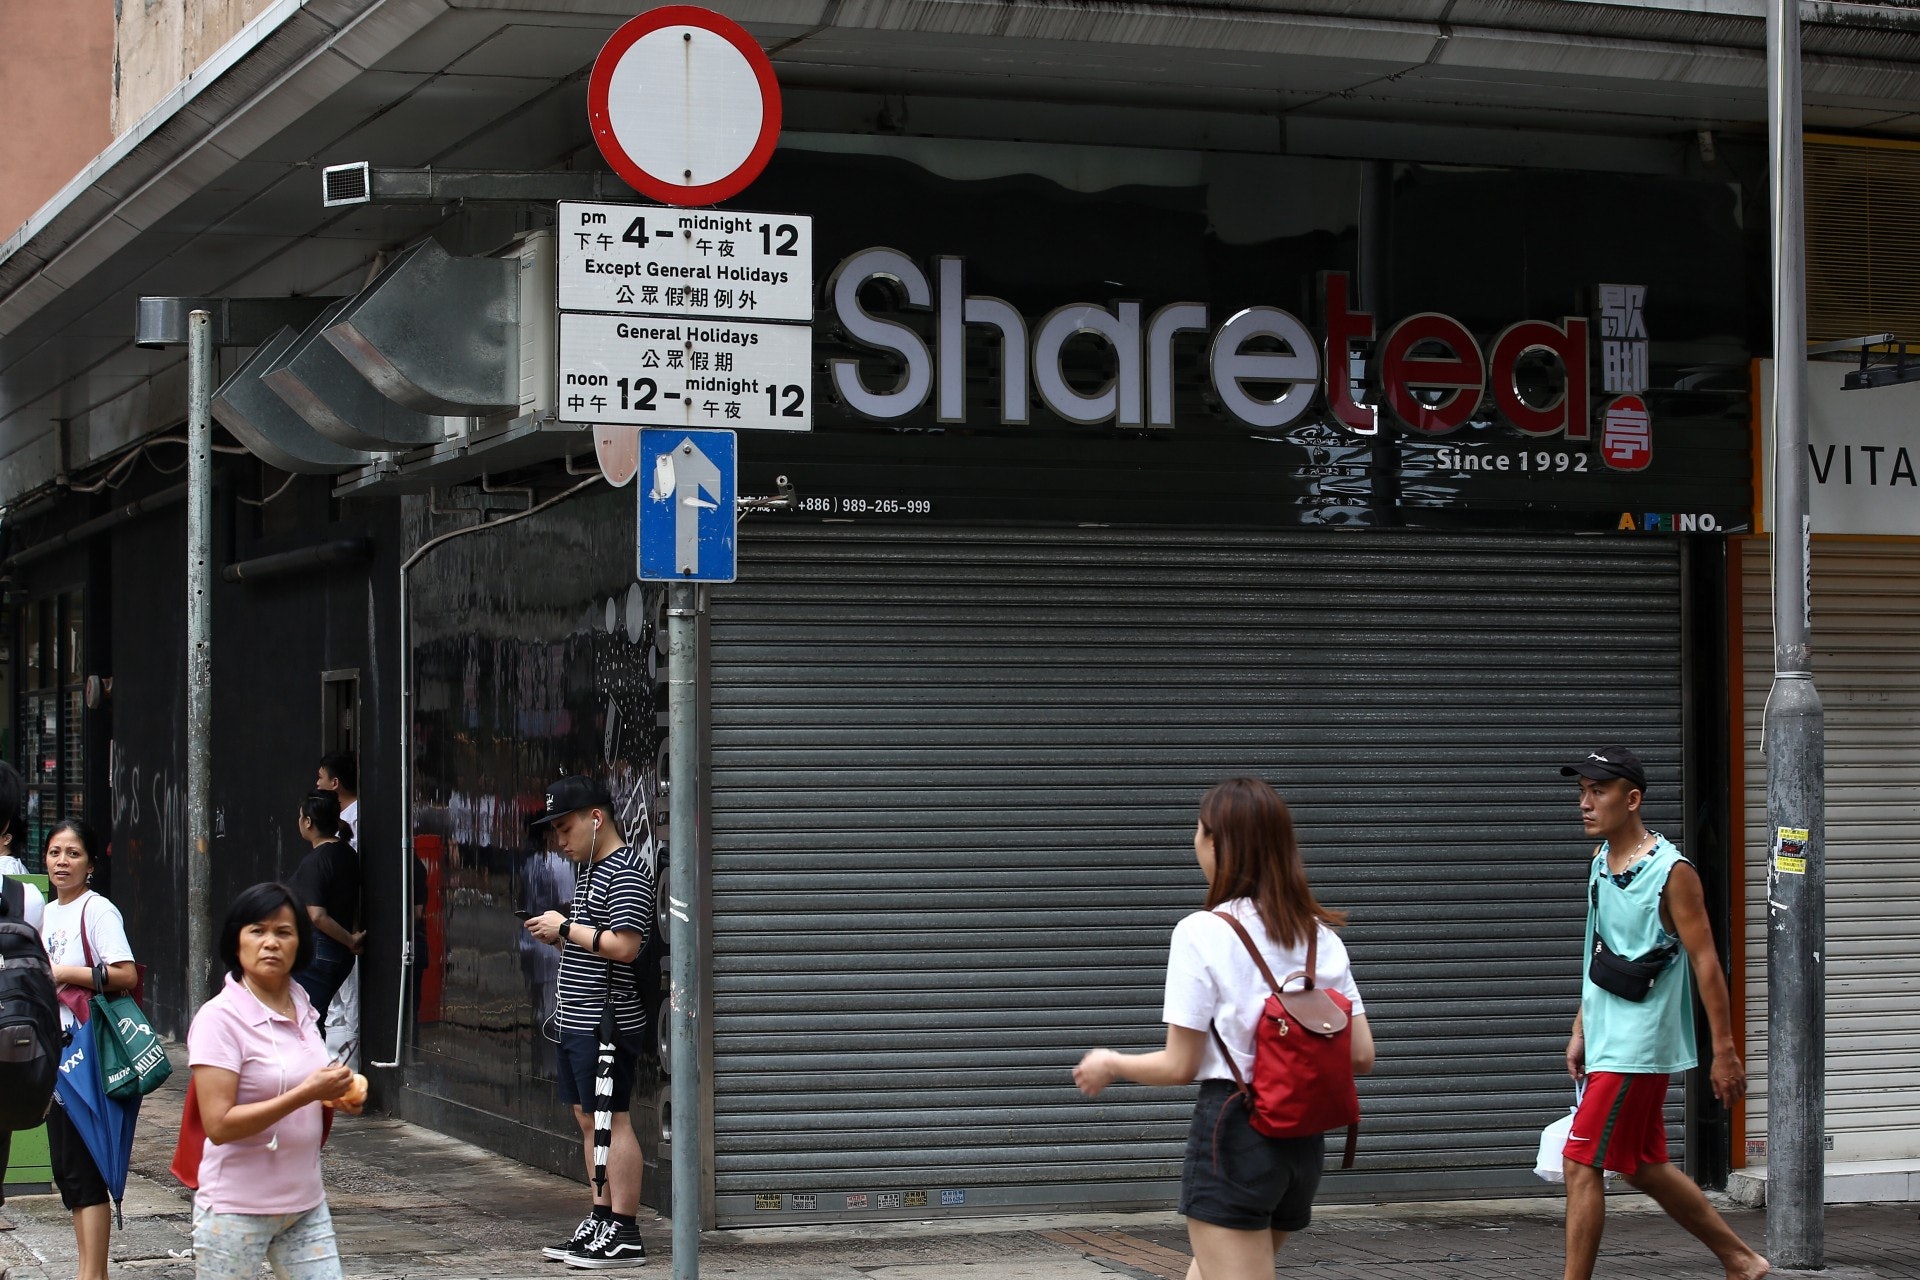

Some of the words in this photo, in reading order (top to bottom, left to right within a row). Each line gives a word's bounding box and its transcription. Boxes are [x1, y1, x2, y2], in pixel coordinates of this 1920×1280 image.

[574, 232, 615, 251] 下午
[695, 238, 736, 258] 午夜
[581, 211, 607, 227] pm
[678, 215, 752, 235] midnight
[758, 223, 799, 257] 12
[585, 258, 642, 277] Except
[646, 261, 711, 279] General
[717, 265, 788, 285] Holidays
[615, 284, 758, 310] 公眾假期例外
[616, 323, 681, 341] General
[687, 327, 759, 347] Holidays
[641, 349, 733, 373] 公眾假期
[566, 373, 608, 386] noon
[685, 377, 759, 396] midnight
[765, 384, 805, 418] 12
[567, 393, 608, 413] 中午
[702, 399, 742, 419] 午夜
[1436, 448, 1510, 471] Since
[1518, 451, 1588, 473] 1992
[1808, 444, 1918, 487] VITA
[842, 498, 931, 513] 989-265-999
[58, 1047, 84, 1073] AXA
